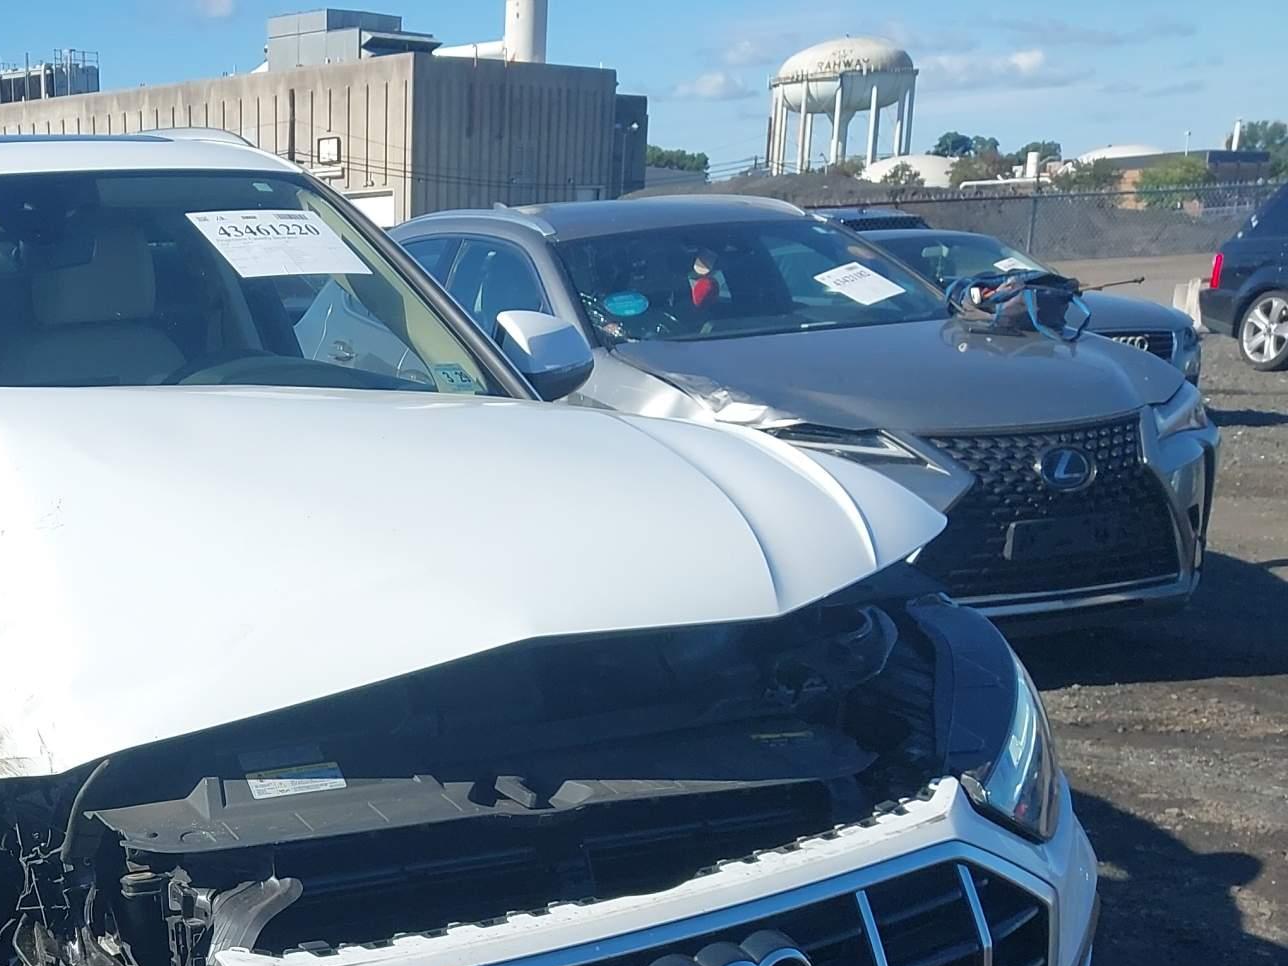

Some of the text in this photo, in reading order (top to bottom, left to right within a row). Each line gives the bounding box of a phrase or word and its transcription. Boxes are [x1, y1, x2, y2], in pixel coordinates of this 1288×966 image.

[817, 58, 870, 72] RAHWAY
[218, 223, 320, 238] 43461220
[442, 371, 454, 383] 3
